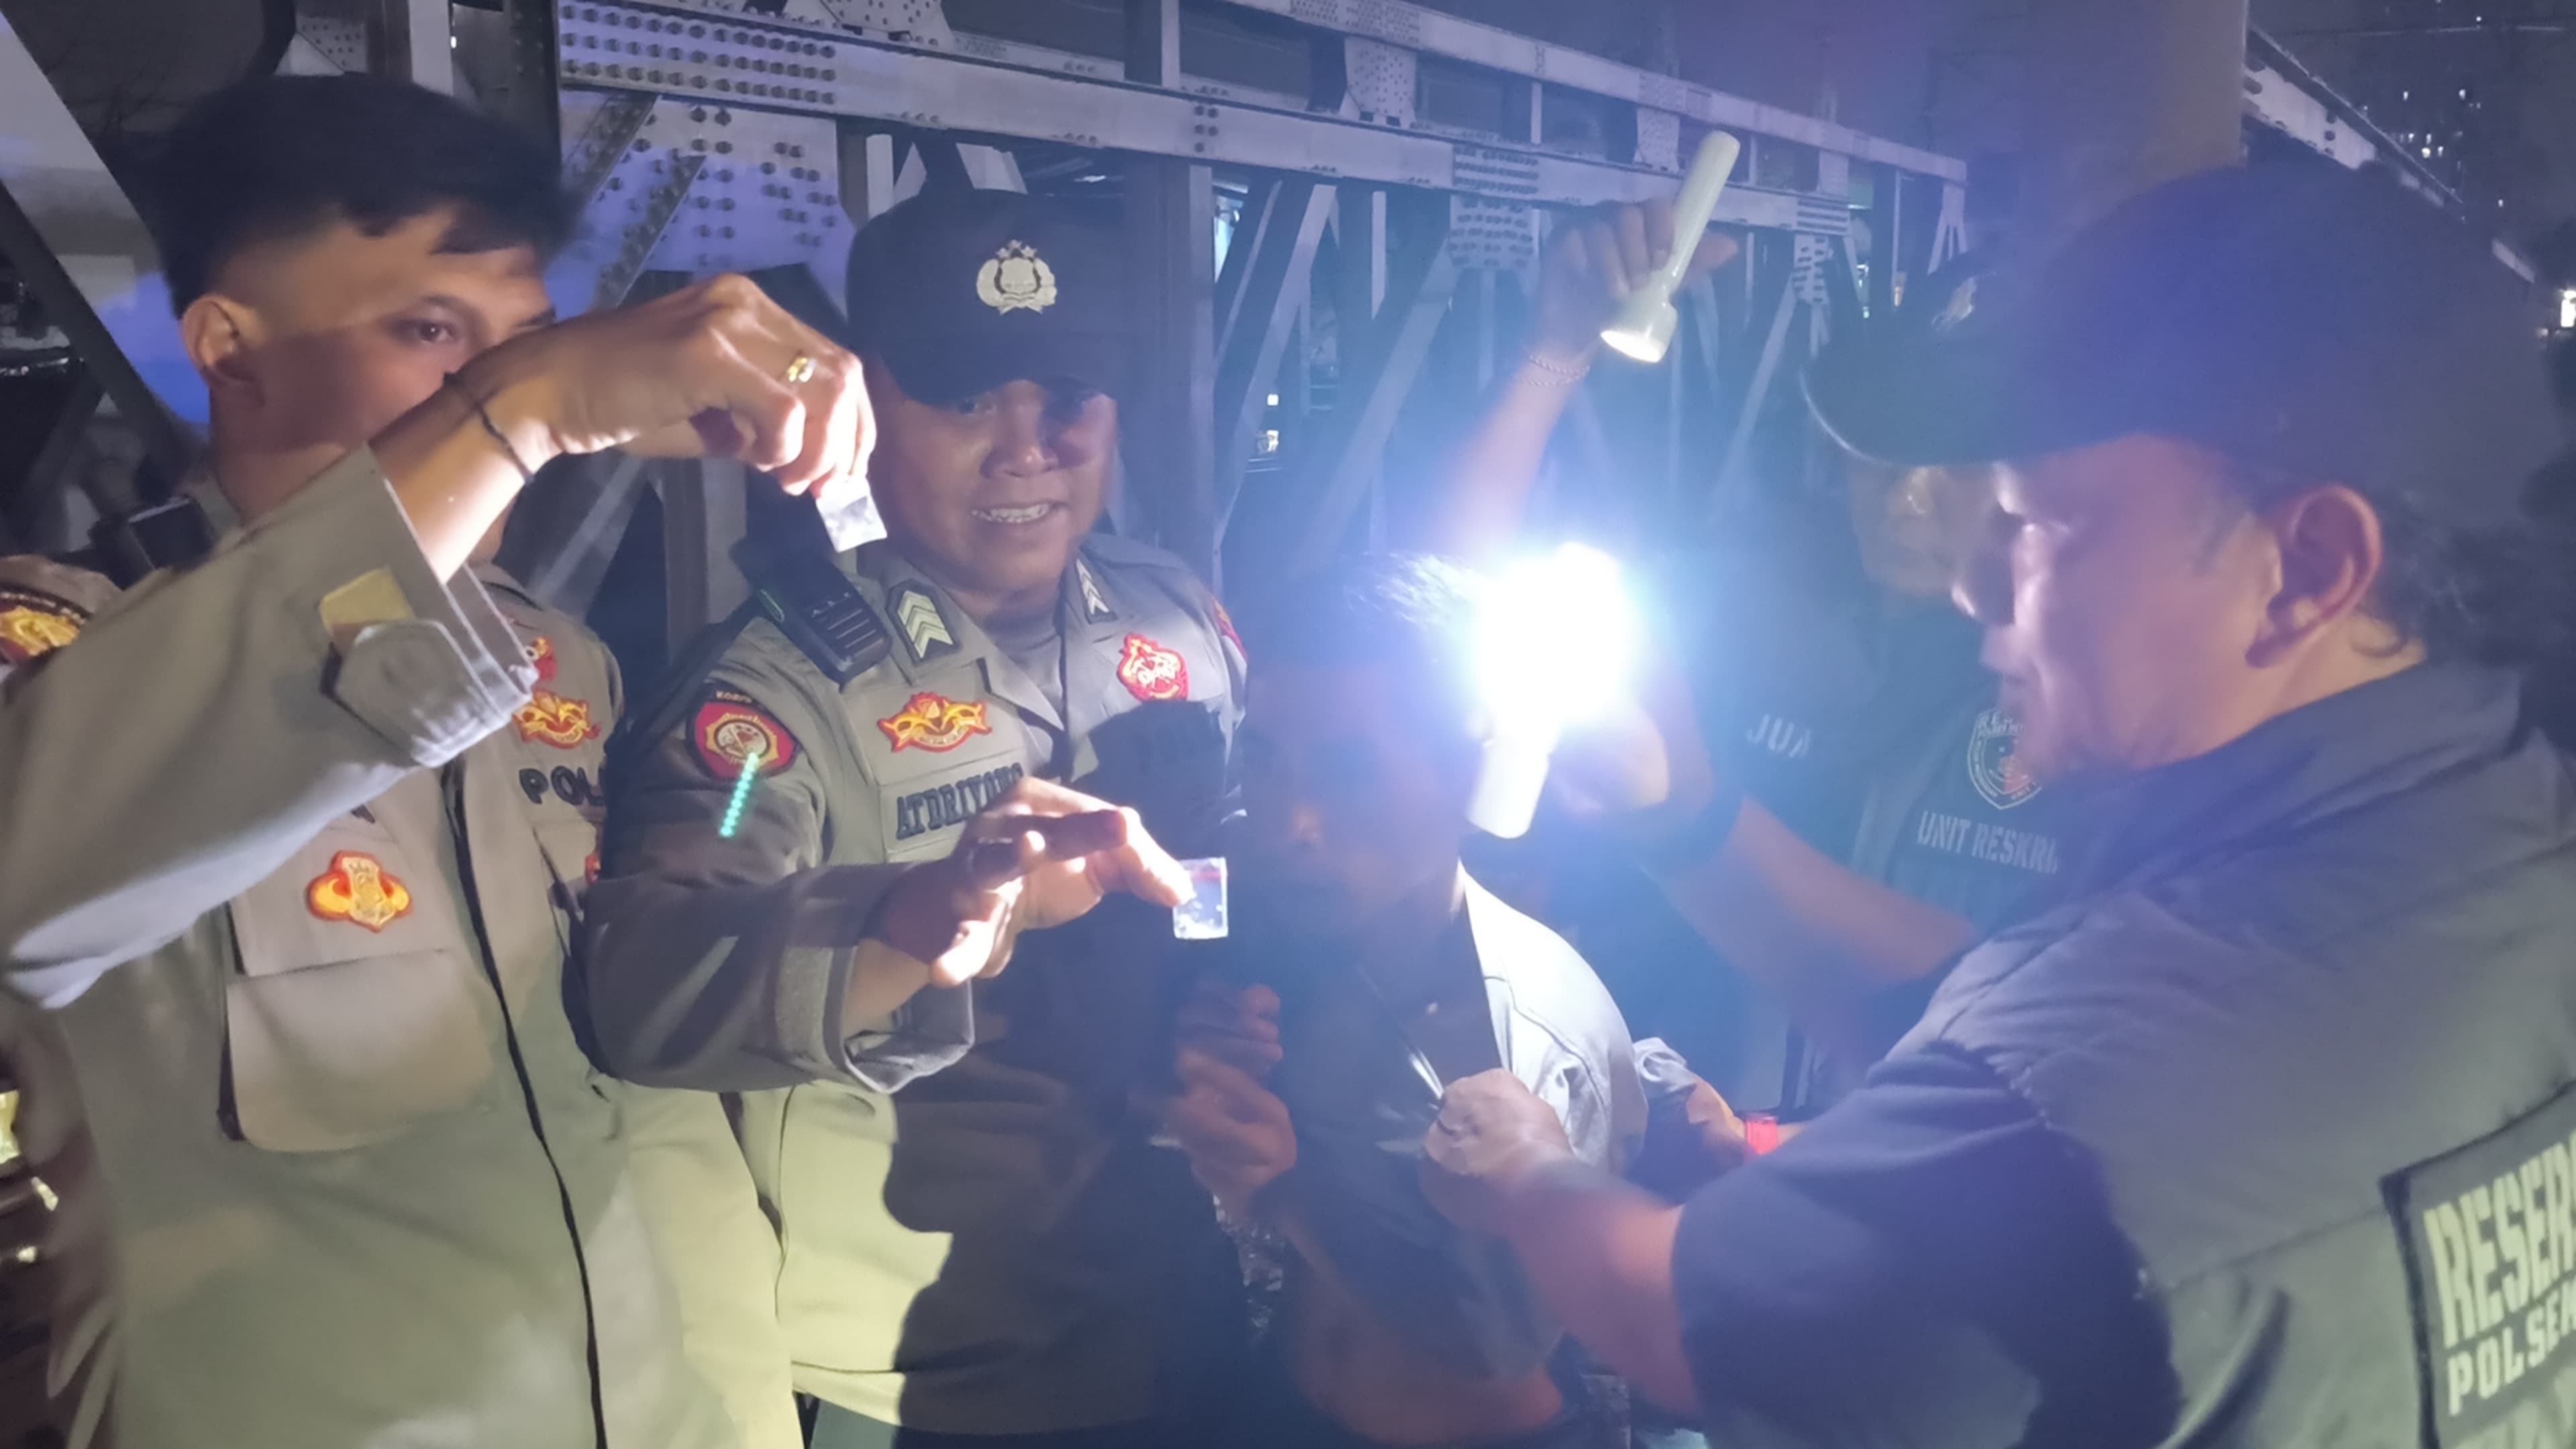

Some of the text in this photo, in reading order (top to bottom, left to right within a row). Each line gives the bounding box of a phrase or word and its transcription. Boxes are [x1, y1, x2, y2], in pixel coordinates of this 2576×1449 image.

[519, 765, 603, 806] POL
[1917, 810, 2059, 875] UNIT RESKRI
